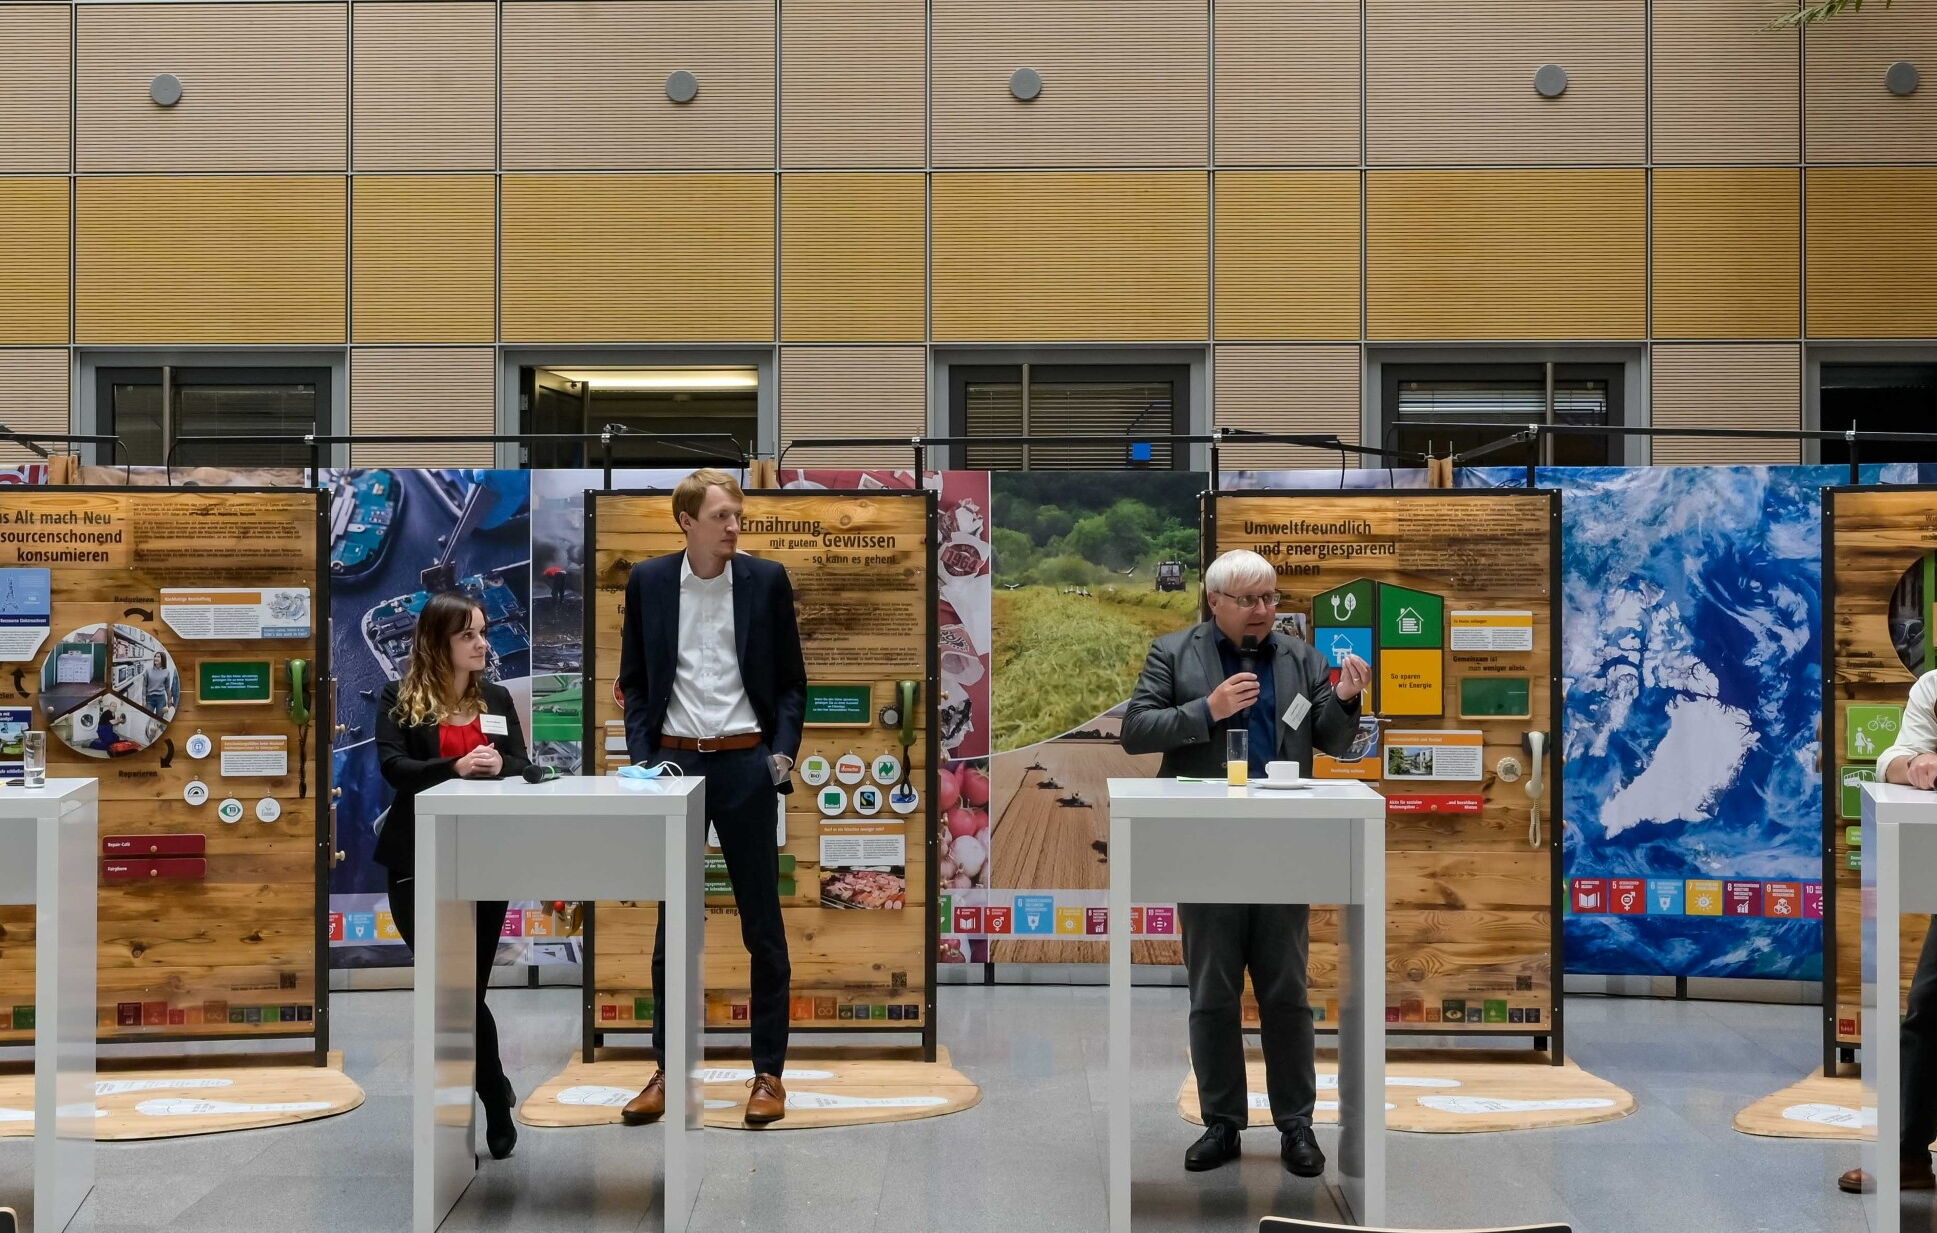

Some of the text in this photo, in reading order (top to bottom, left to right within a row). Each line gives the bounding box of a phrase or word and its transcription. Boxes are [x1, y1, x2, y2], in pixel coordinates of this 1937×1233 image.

[14, 510, 35, 524] Alt
[40, 510, 77, 524] mach
[83, 511, 111, 524] Neu
[740, 516, 821, 537] Ernährung
[1244, 520, 1371, 535] Umweltfreundlich
[0, 529, 122, 543] sourcenschonend
[769, 532, 896, 549] mit gutem Gewissen
[17, 547, 109, 562] konsumieren
[1253, 541, 1396, 559] und energiesparend
[812, 556, 822, 564] so
[825, 554, 849, 564] kann
[851, 556, 861, 564] es
[1574, 881, 1579, 889] 4
[1612, 881, 1617, 889] 5
[1650, 881, 1655, 890] 6
[1727, 883, 1732, 891] 8
[1766, 884, 1772, 892] 9
[1806, 885, 1814, 893] 10
